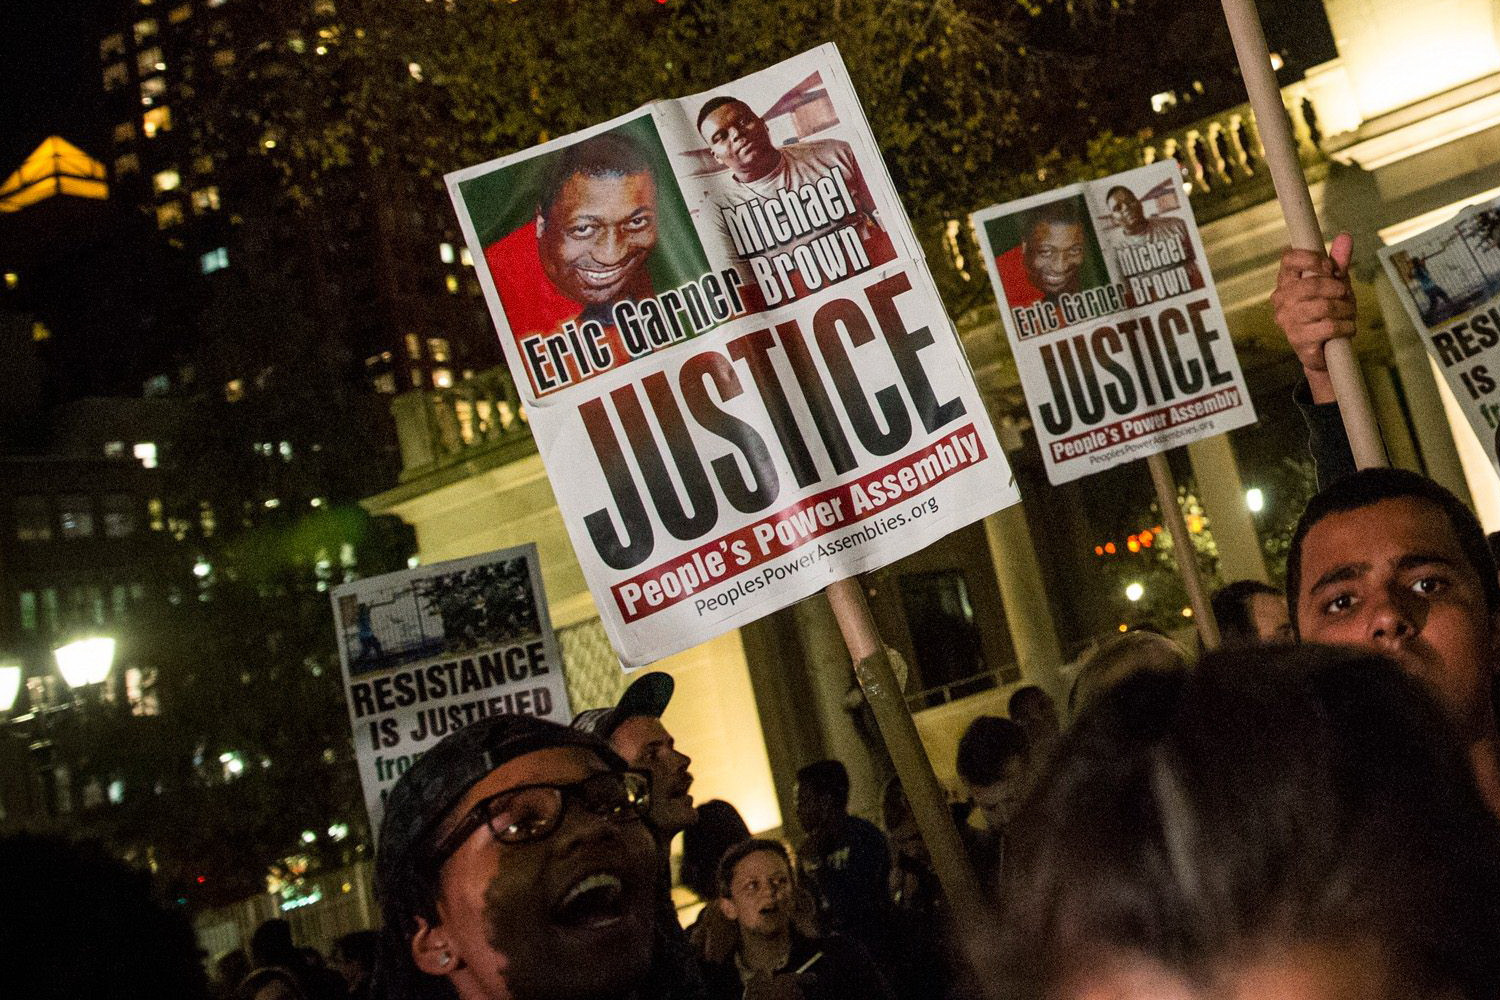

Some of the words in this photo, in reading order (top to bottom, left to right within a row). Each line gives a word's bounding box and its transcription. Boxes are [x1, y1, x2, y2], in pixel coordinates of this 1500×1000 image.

[723, 166, 858, 260] Michael
[755, 222, 872, 309] Brown
[1116, 234, 1187, 275] Michael
[1131, 266, 1192, 305] Brown
[522, 319, 612, 396] Eric
[612, 263, 744, 356] Garner
[1012, 299, 1059, 339] Eric
[1061, 282, 1127, 323] Garner
[1038, 299, 1233, 436] JUSTICE
[1460, 365, 1496, 400] IS
[580, 271, 967, 572] JUSTICE
[1054, 425, 1121, 461] People's
[1122, 413, 1168, 440] Power
[1170, 388, 1240, 425] Assembly
[618, 538, 752, 616] People's
[757, 497, 843, 557] Power
[849, 430, 982, 514] Assembly
[693, 496, 939, 617] PeoplesPowerAssemblies.org
[350, 642, 550, 718] RESISTANCE
[369, 717, 400, 750] IS
[410, 687, 553, 742] JUSTIFIED
